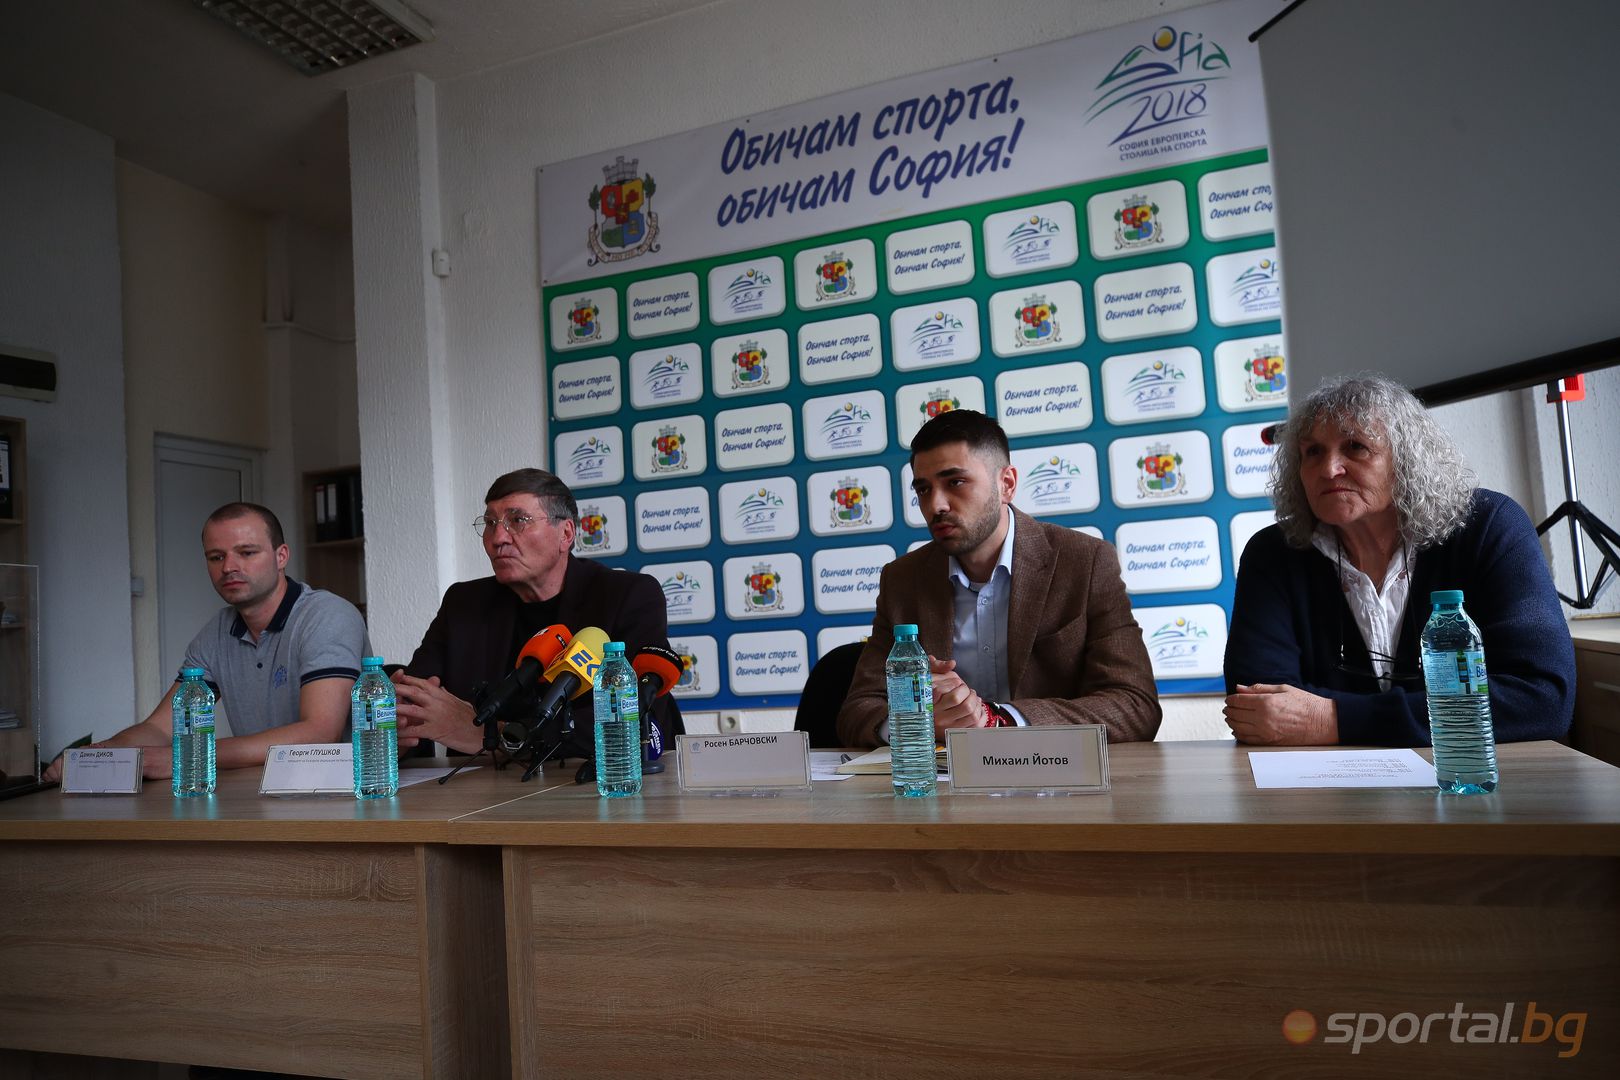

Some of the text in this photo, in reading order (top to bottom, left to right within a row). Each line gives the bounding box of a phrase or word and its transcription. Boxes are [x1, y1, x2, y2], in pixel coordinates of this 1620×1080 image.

[1108, 83, 1208, 147] 2018
[721, 76, 1019, 175] Обичам спорта,
[1119, 139, 1149, 152] СОФИЯ
[1120, 139, 1208, 161] СТОЛИЦА НА СПОРТА
[717, 117, 1025, 228] обичам София!
[931, 254, 965, 269] София!
[664, 303, 693, 316] София!
[1147, 299, 1186, 315] София!
[841, 347, 873, 361] София!
[587, 386, 614, 399] София!
[1045, 397, 1083, 413] София!
[755, 436, 786, 449] София!
[673, 519, 703, 532] София!
[1170, 555, 1210, 570] София!
[769, 664, 801, 676] София!
[704, 735, 778, 748] Росен БАРЧОВСКИ
[289, 749, 309, 758] Георги
[982, 753, 1069, 766] Михаил Йотов
